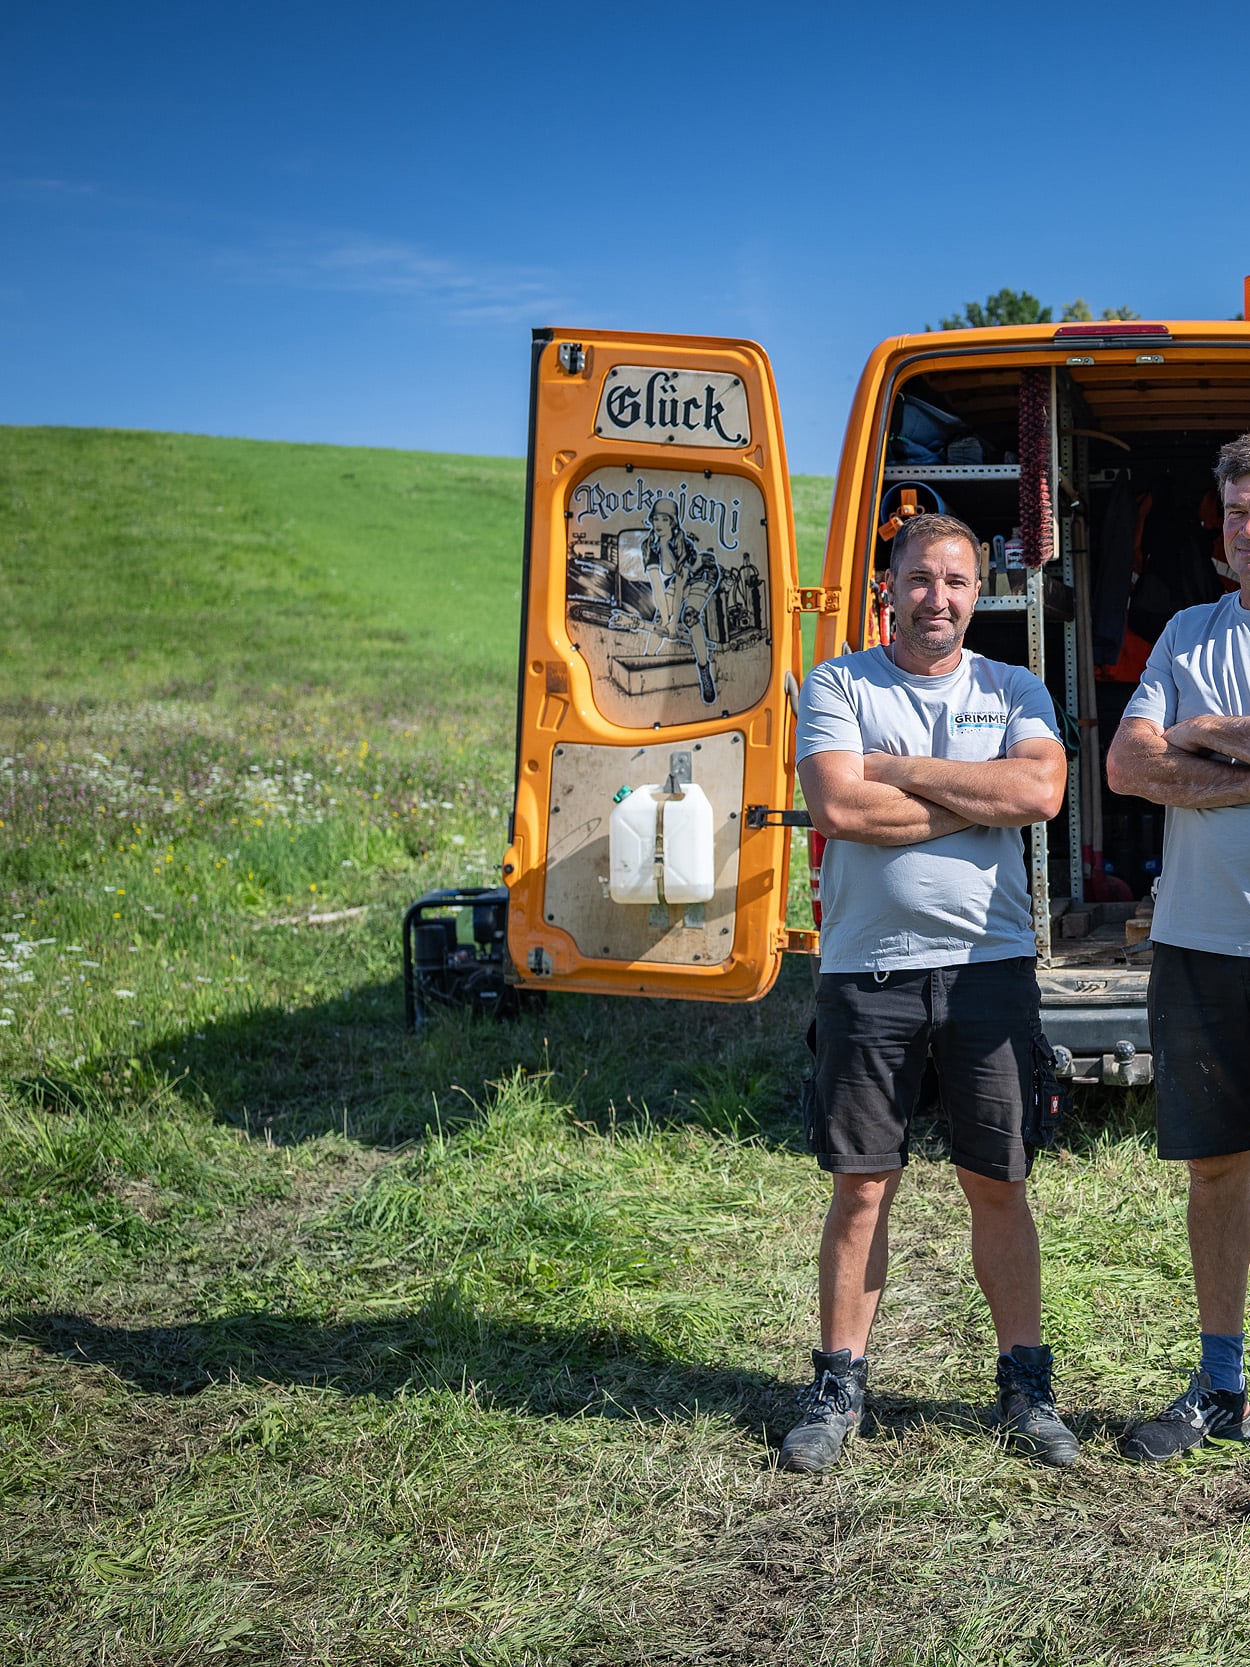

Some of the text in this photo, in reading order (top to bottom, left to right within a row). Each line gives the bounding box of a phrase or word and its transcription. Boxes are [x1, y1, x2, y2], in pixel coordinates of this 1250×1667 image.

[606, 371, 742, 443] Glück
[574, 478, 738, 549] Rockjani
[954, 714, 1007, 725] GRIMME
